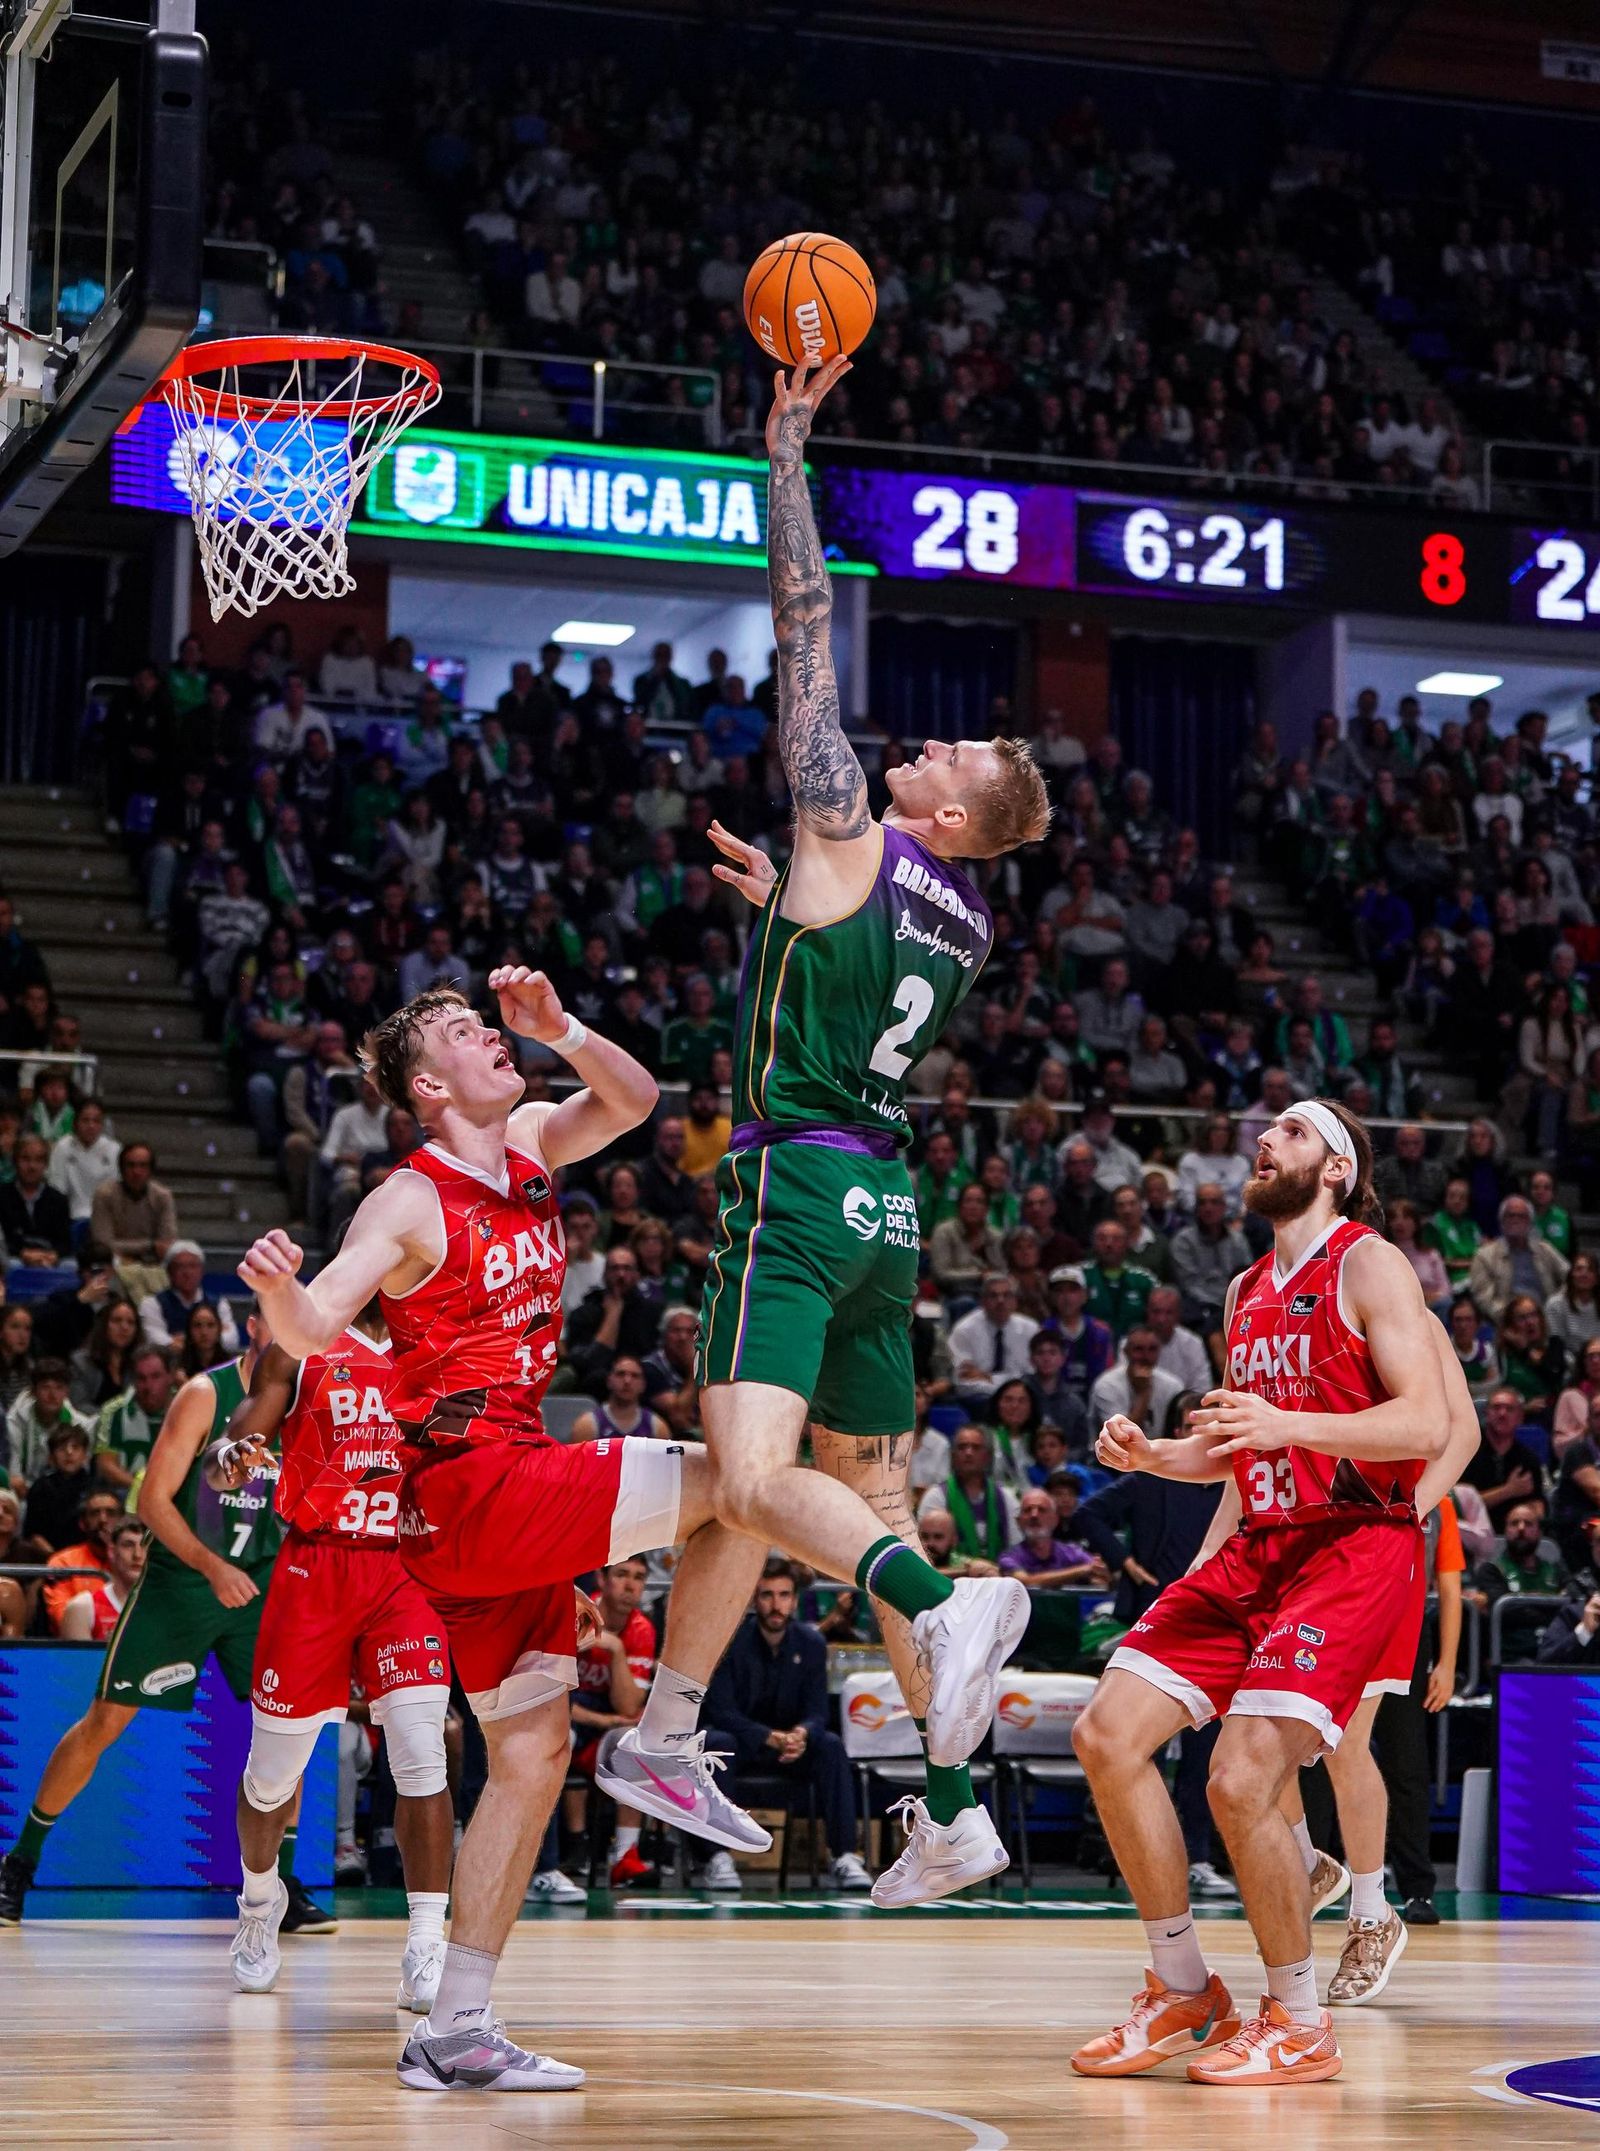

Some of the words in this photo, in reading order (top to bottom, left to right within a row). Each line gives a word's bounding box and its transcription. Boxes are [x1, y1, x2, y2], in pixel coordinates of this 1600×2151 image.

[506, 463, 762, 545] UNICAJA
[912, 485, 1019, 575] 28
[1123, 507, 1285, 591] 6:21
[1420, 532, 1466, 605] 8
[868, 974, 934, 1081] 2
[882, 1194, 917, 1216] COST
[886, 1213, 911, 1231] DEL
[482, 1215, 567, 1293] BAXI
[1231, 1334, 1312, 1387] BAXI
[328, 1386, 396, 1427] BA
[333, 1427, 405, 1442] CLIMATIZAC
[344, 1450, 402, 1473] MANRES
[1248, 1458, 1297, 1511] 33
[338, 1489, 399, 1537] 32
[230, 1523, 253, 1558] 7
[1300, 1630, 1318, 1642] acb
[378, 1657, 398, 1677] ETL
[1246, 1655, 1286, 1671] OBAL
[663, 1731, 696, 1744] PET
[453, 2008, 486, 2022] PET
